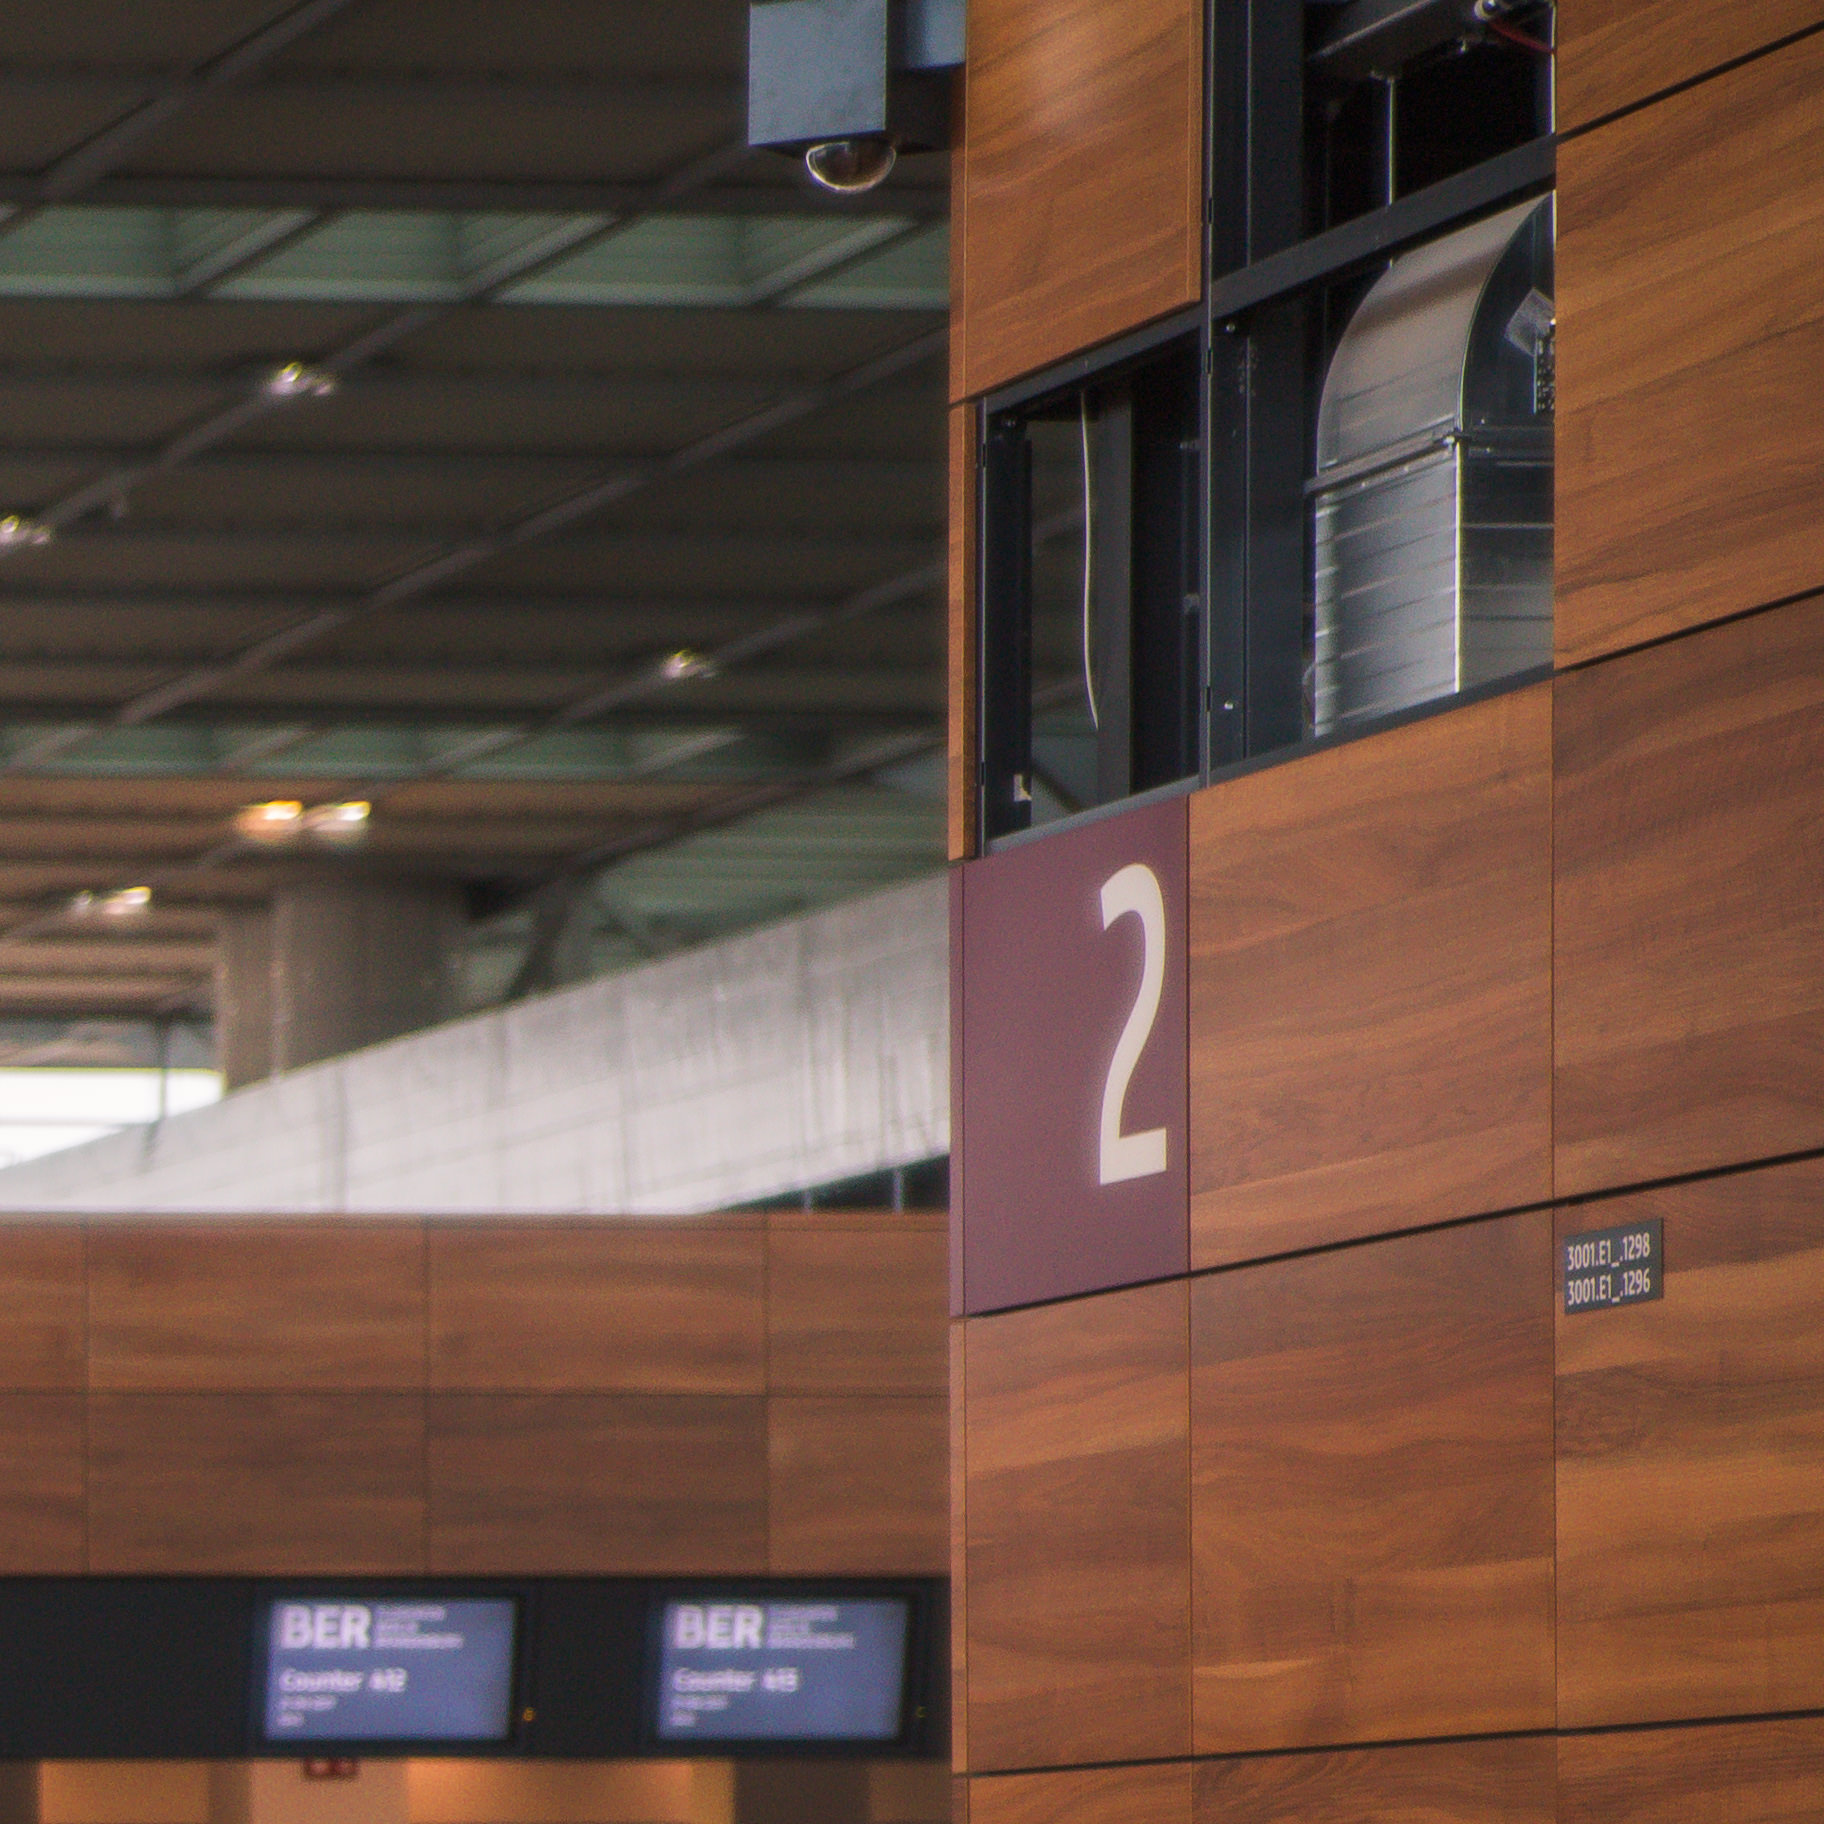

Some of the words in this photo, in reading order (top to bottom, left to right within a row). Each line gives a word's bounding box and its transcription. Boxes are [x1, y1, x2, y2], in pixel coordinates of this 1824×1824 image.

[1099, 863, 1167, 1185] 2
[280, 1604, 371, 1649] BER
[675, 1604, 763, 1649] BER
